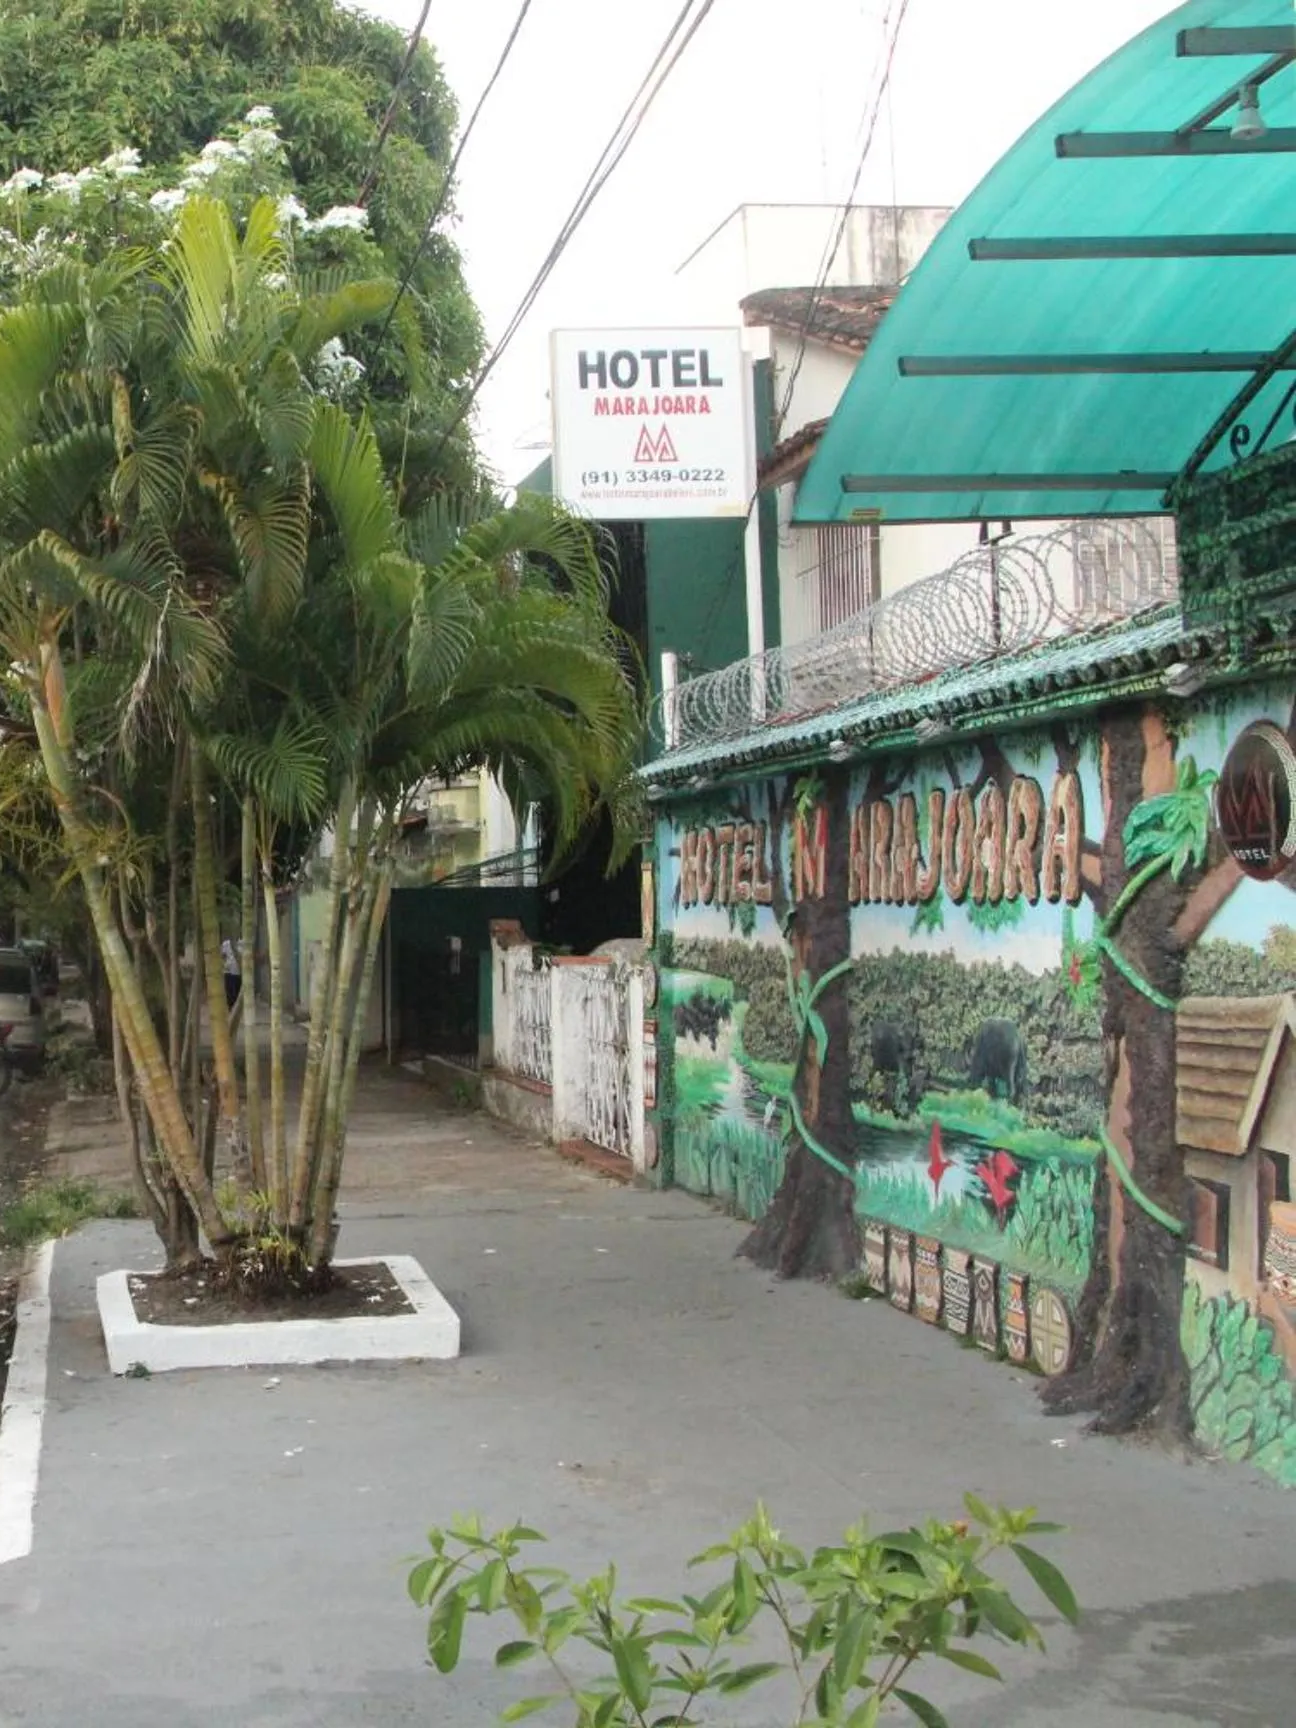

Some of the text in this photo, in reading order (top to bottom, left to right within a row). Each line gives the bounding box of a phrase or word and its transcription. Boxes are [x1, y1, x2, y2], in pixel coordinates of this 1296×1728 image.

[577, 348, 723, 389] HOTEL
[594, 395, 711, 416] MARAJOARA
[581, 468, 725, 487] (91) 3349-0222
[680, 772, 1081, 906] HOTEL MARAJOARA
